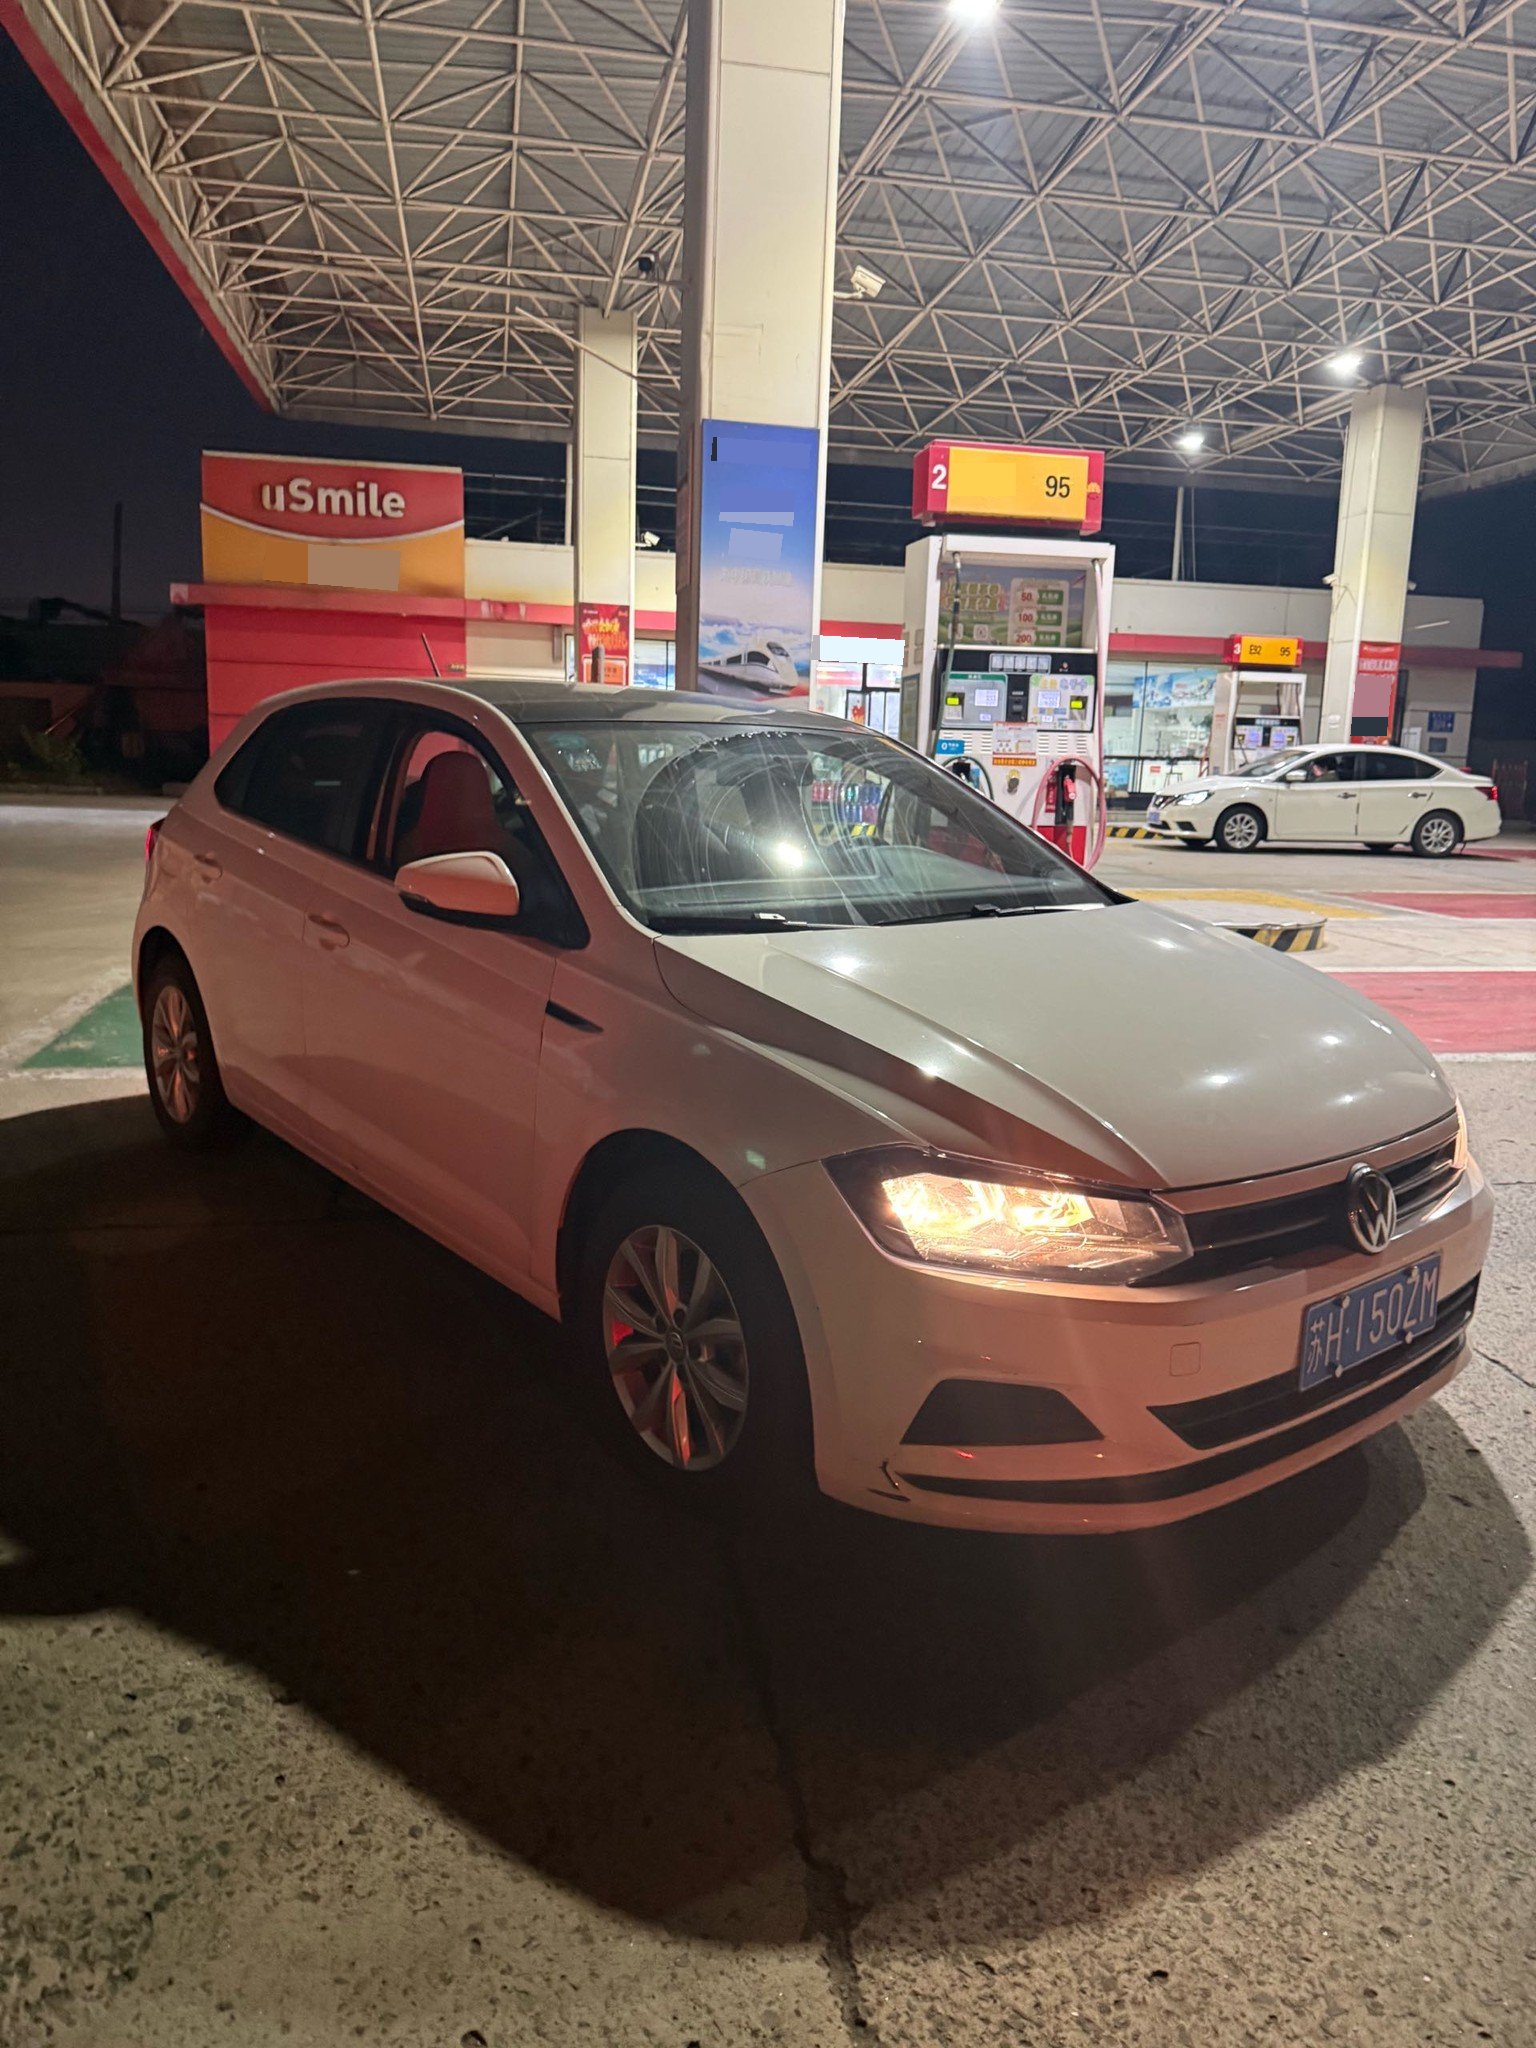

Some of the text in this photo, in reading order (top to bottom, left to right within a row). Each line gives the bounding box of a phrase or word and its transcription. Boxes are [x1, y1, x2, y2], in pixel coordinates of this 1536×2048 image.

[931, 464, 1070, 498] 2 95
[261, 477, 406, 519] uSmile
[1019, 613, 1033, 623] 100
[1016, 633, 1031, 643] 200
[1233, 643, 1241, 655] 3
[1280, 646, 1291, 657] 95
